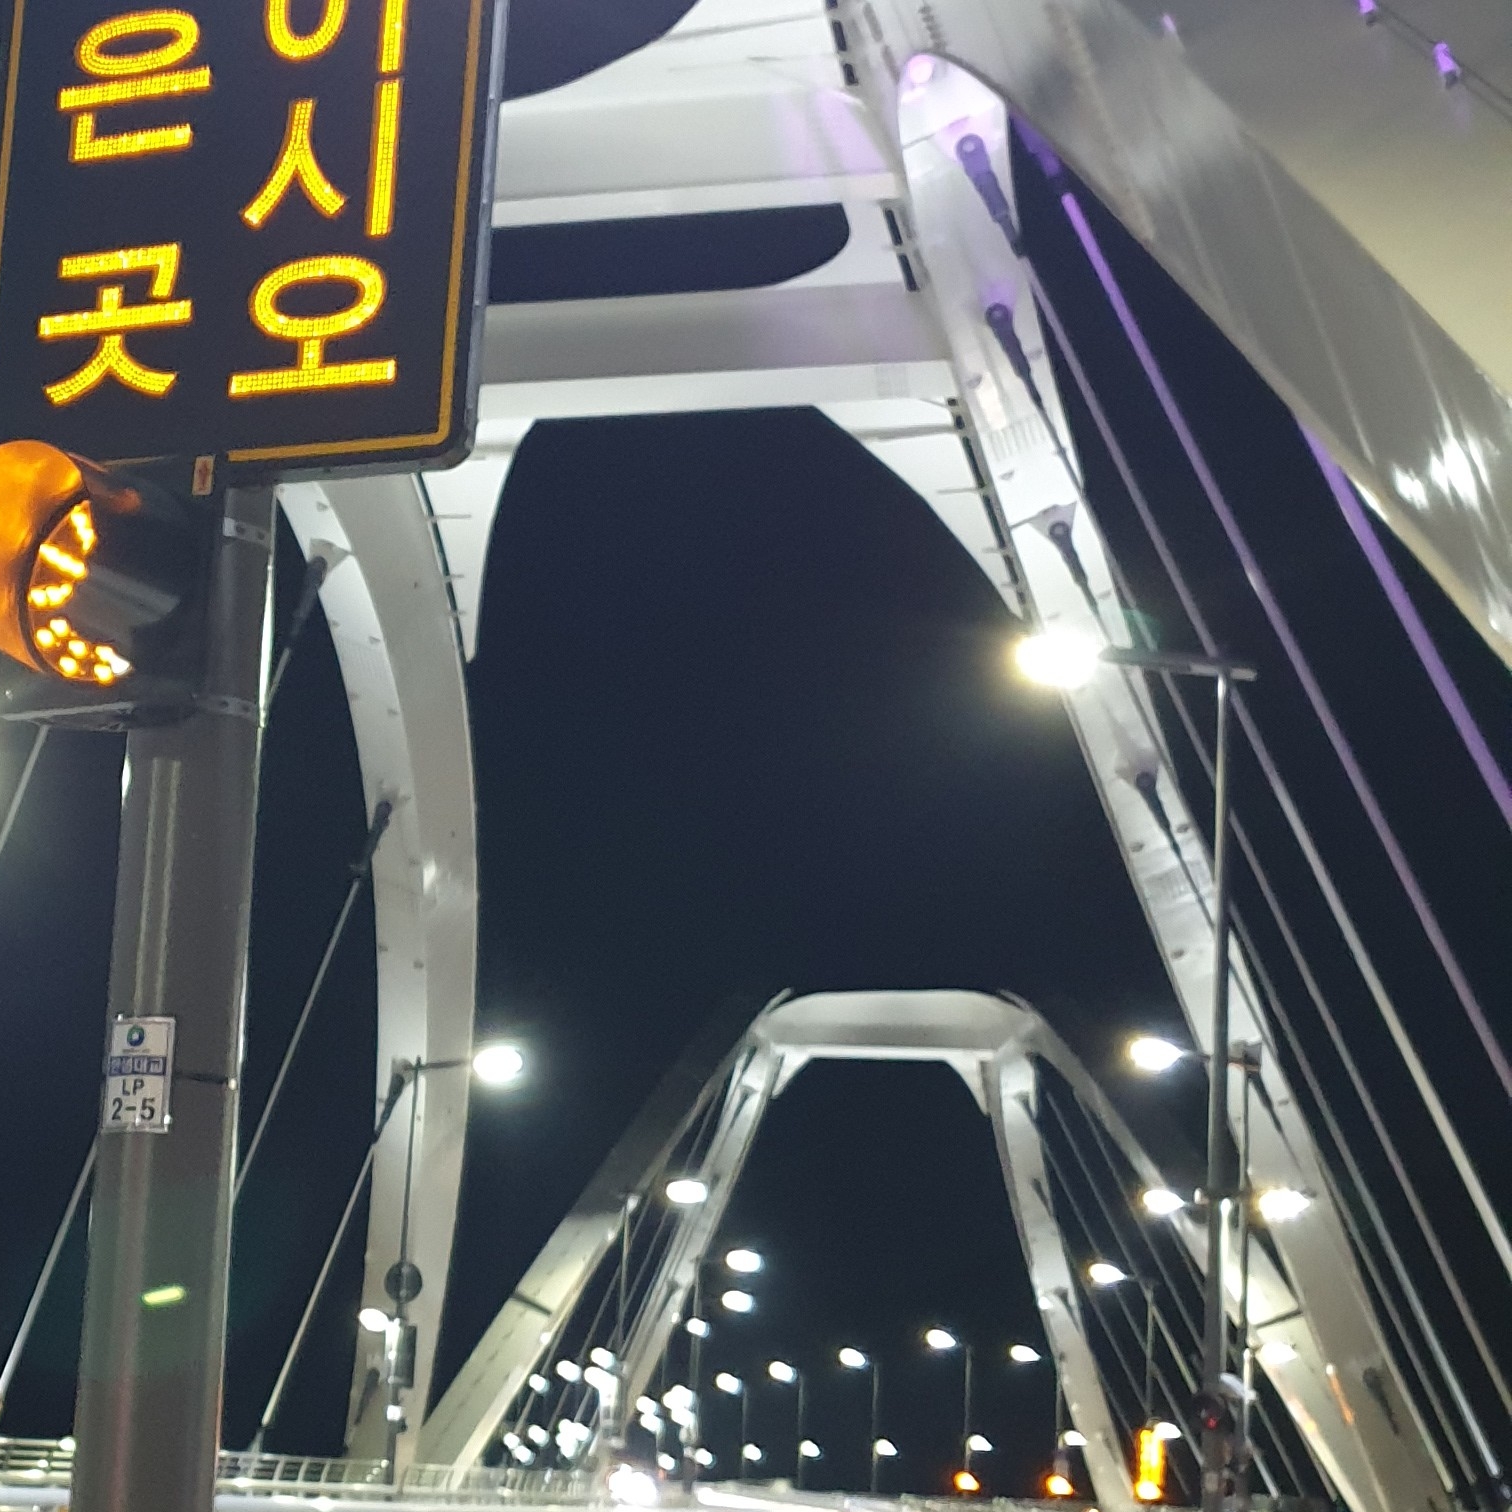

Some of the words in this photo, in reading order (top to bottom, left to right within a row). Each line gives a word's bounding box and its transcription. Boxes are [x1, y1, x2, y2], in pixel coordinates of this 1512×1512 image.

[58, 8, 212, 163] 은
[37, 241, 193, 405] 곳
[111, 1097, 155, 1121] 2-5
[122, 1078, 145, 1096] LP
